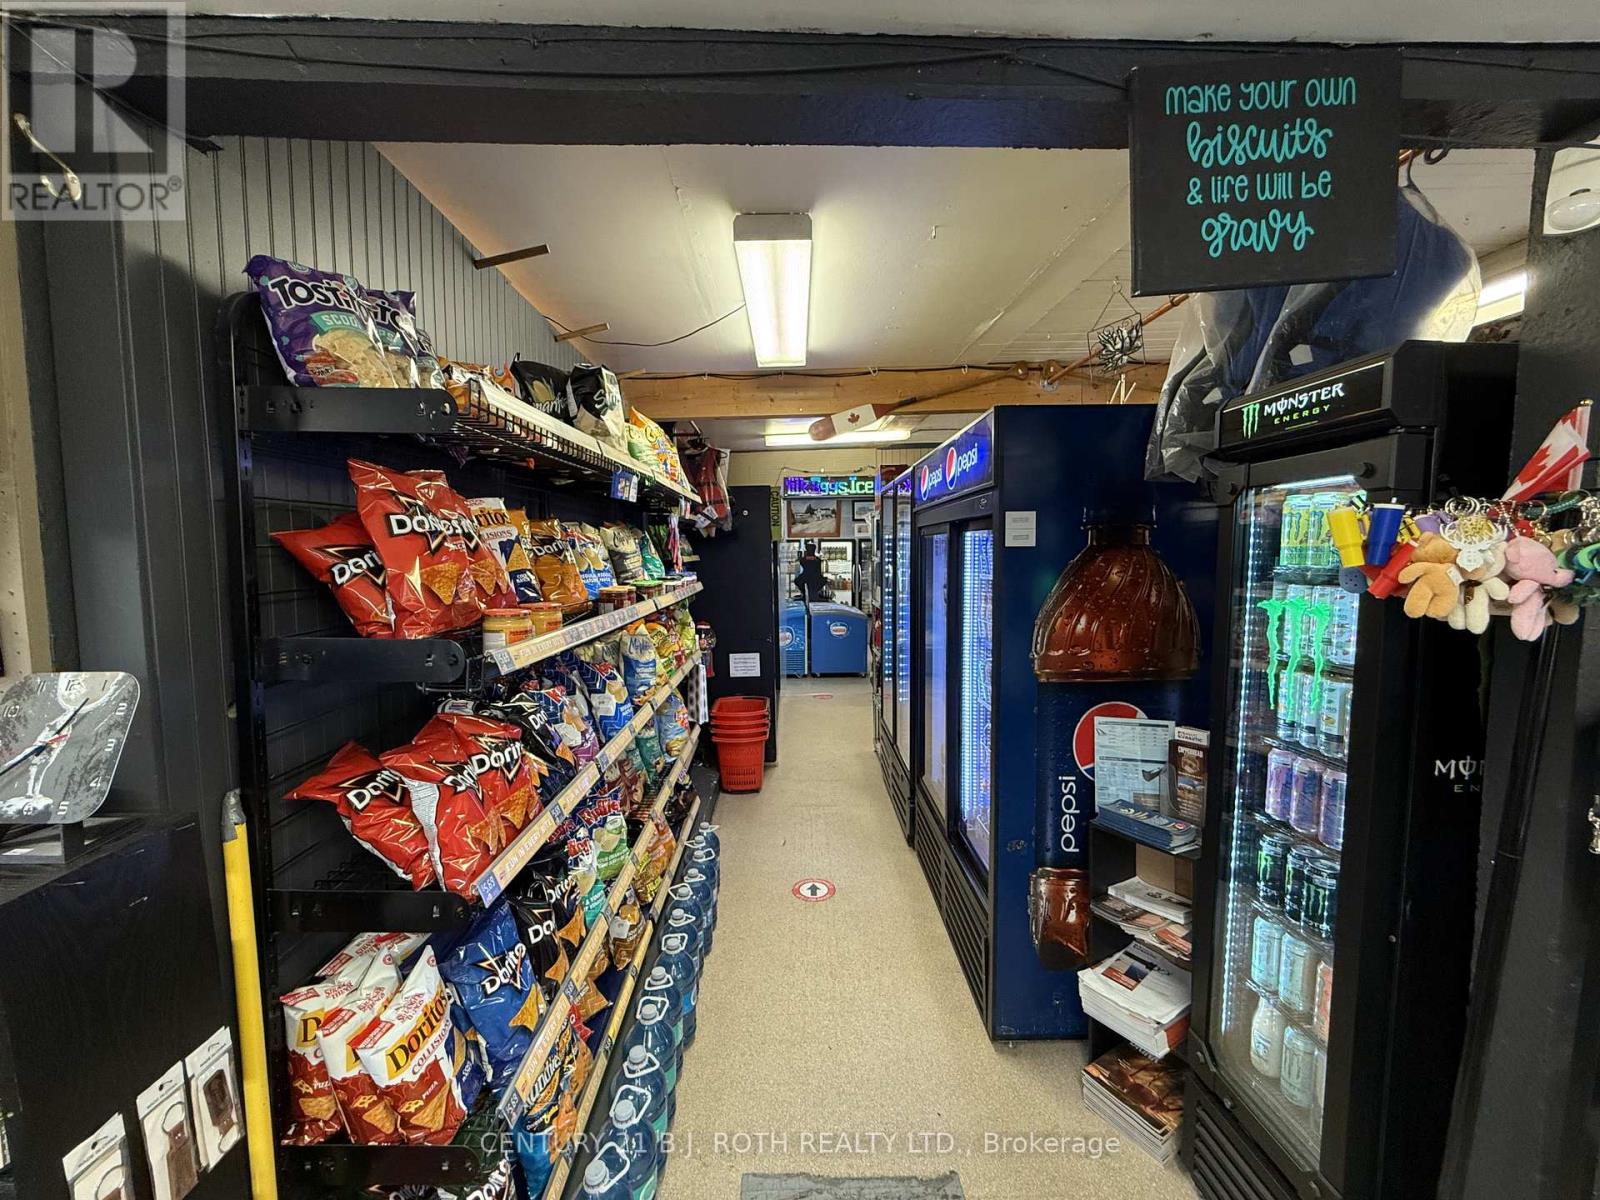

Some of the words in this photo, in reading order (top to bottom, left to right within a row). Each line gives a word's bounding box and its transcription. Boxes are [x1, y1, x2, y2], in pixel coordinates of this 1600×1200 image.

[1165, 83, 1231, 115] make
[1239, 79, 1297, 111] your
[1304, 76, 1356, 106] own
[1186, 117, 1333, 168] biscuits
[1186, 177, 1202, 205] &
[1210, 174, 1248, 203] life
[1256, 172, 1292, 200] will
[1301, 170, 1331, 199] be
[1201, 208, 1314, 258] gravy
[1274, 404, 1330, 425] ENERGY
[956, 443, 978, 476] pepsi
[928, 464, 942, 490] pepsi
[772, 490, 781, 527] CAUTION
[115, 702, 128, 715] 2
[104, 738, 115, 751] 3
[89, 776, 102, 788] 4
[57, 800, 70, 815] 5
[1058, 776, 1080, 852] pepsi
[412, 1019, 450, 1076] COLLISIONS
[422, 1080, 438, 1099] PIZZA
